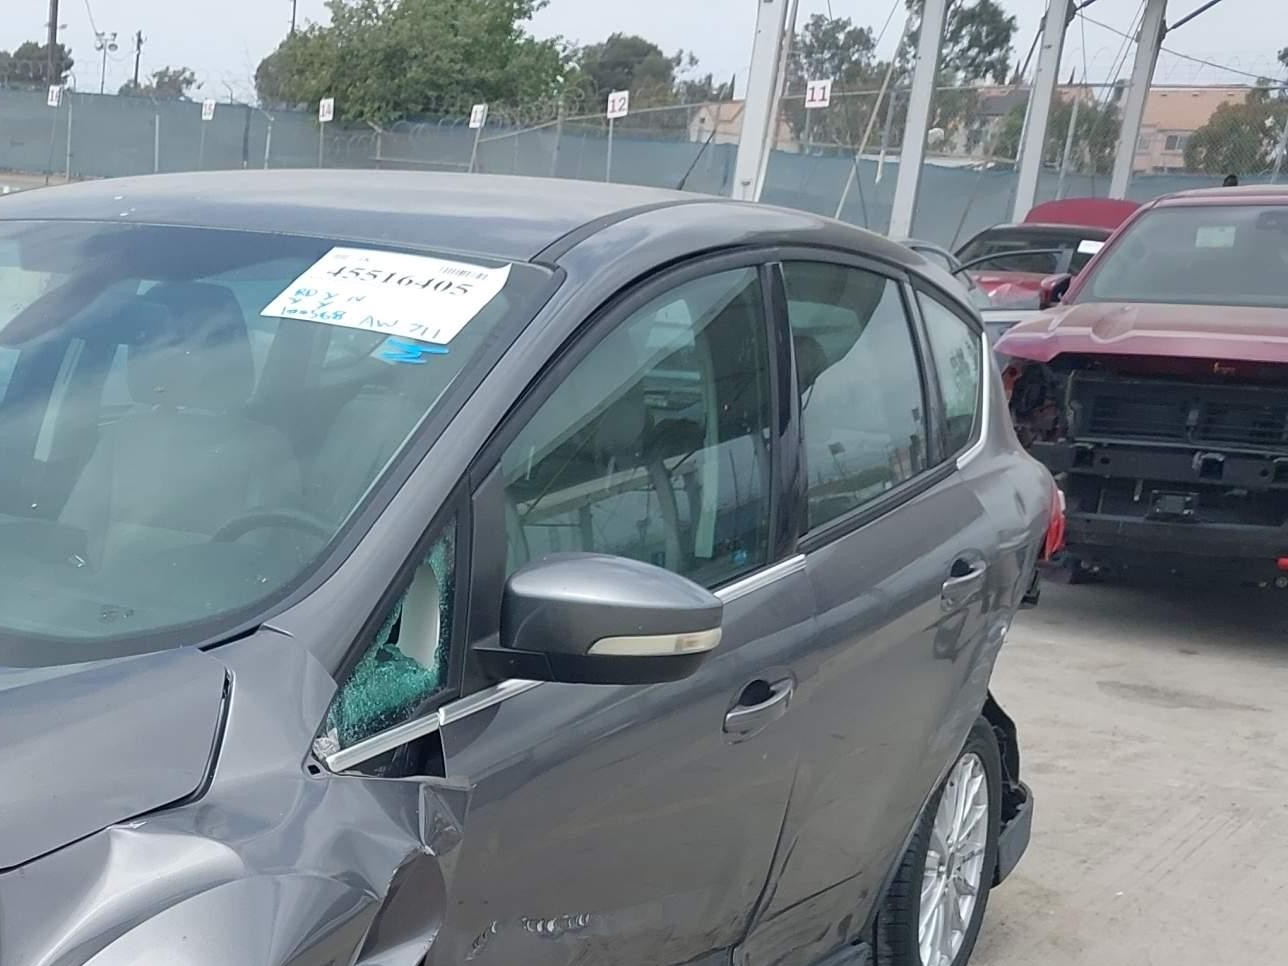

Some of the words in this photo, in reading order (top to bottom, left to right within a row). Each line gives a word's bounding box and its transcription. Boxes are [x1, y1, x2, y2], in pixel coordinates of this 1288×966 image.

[808, 85, 828, 102] 11
[609, 97, 626, 113] 12
[326, 266, 474, 296] 45516405
